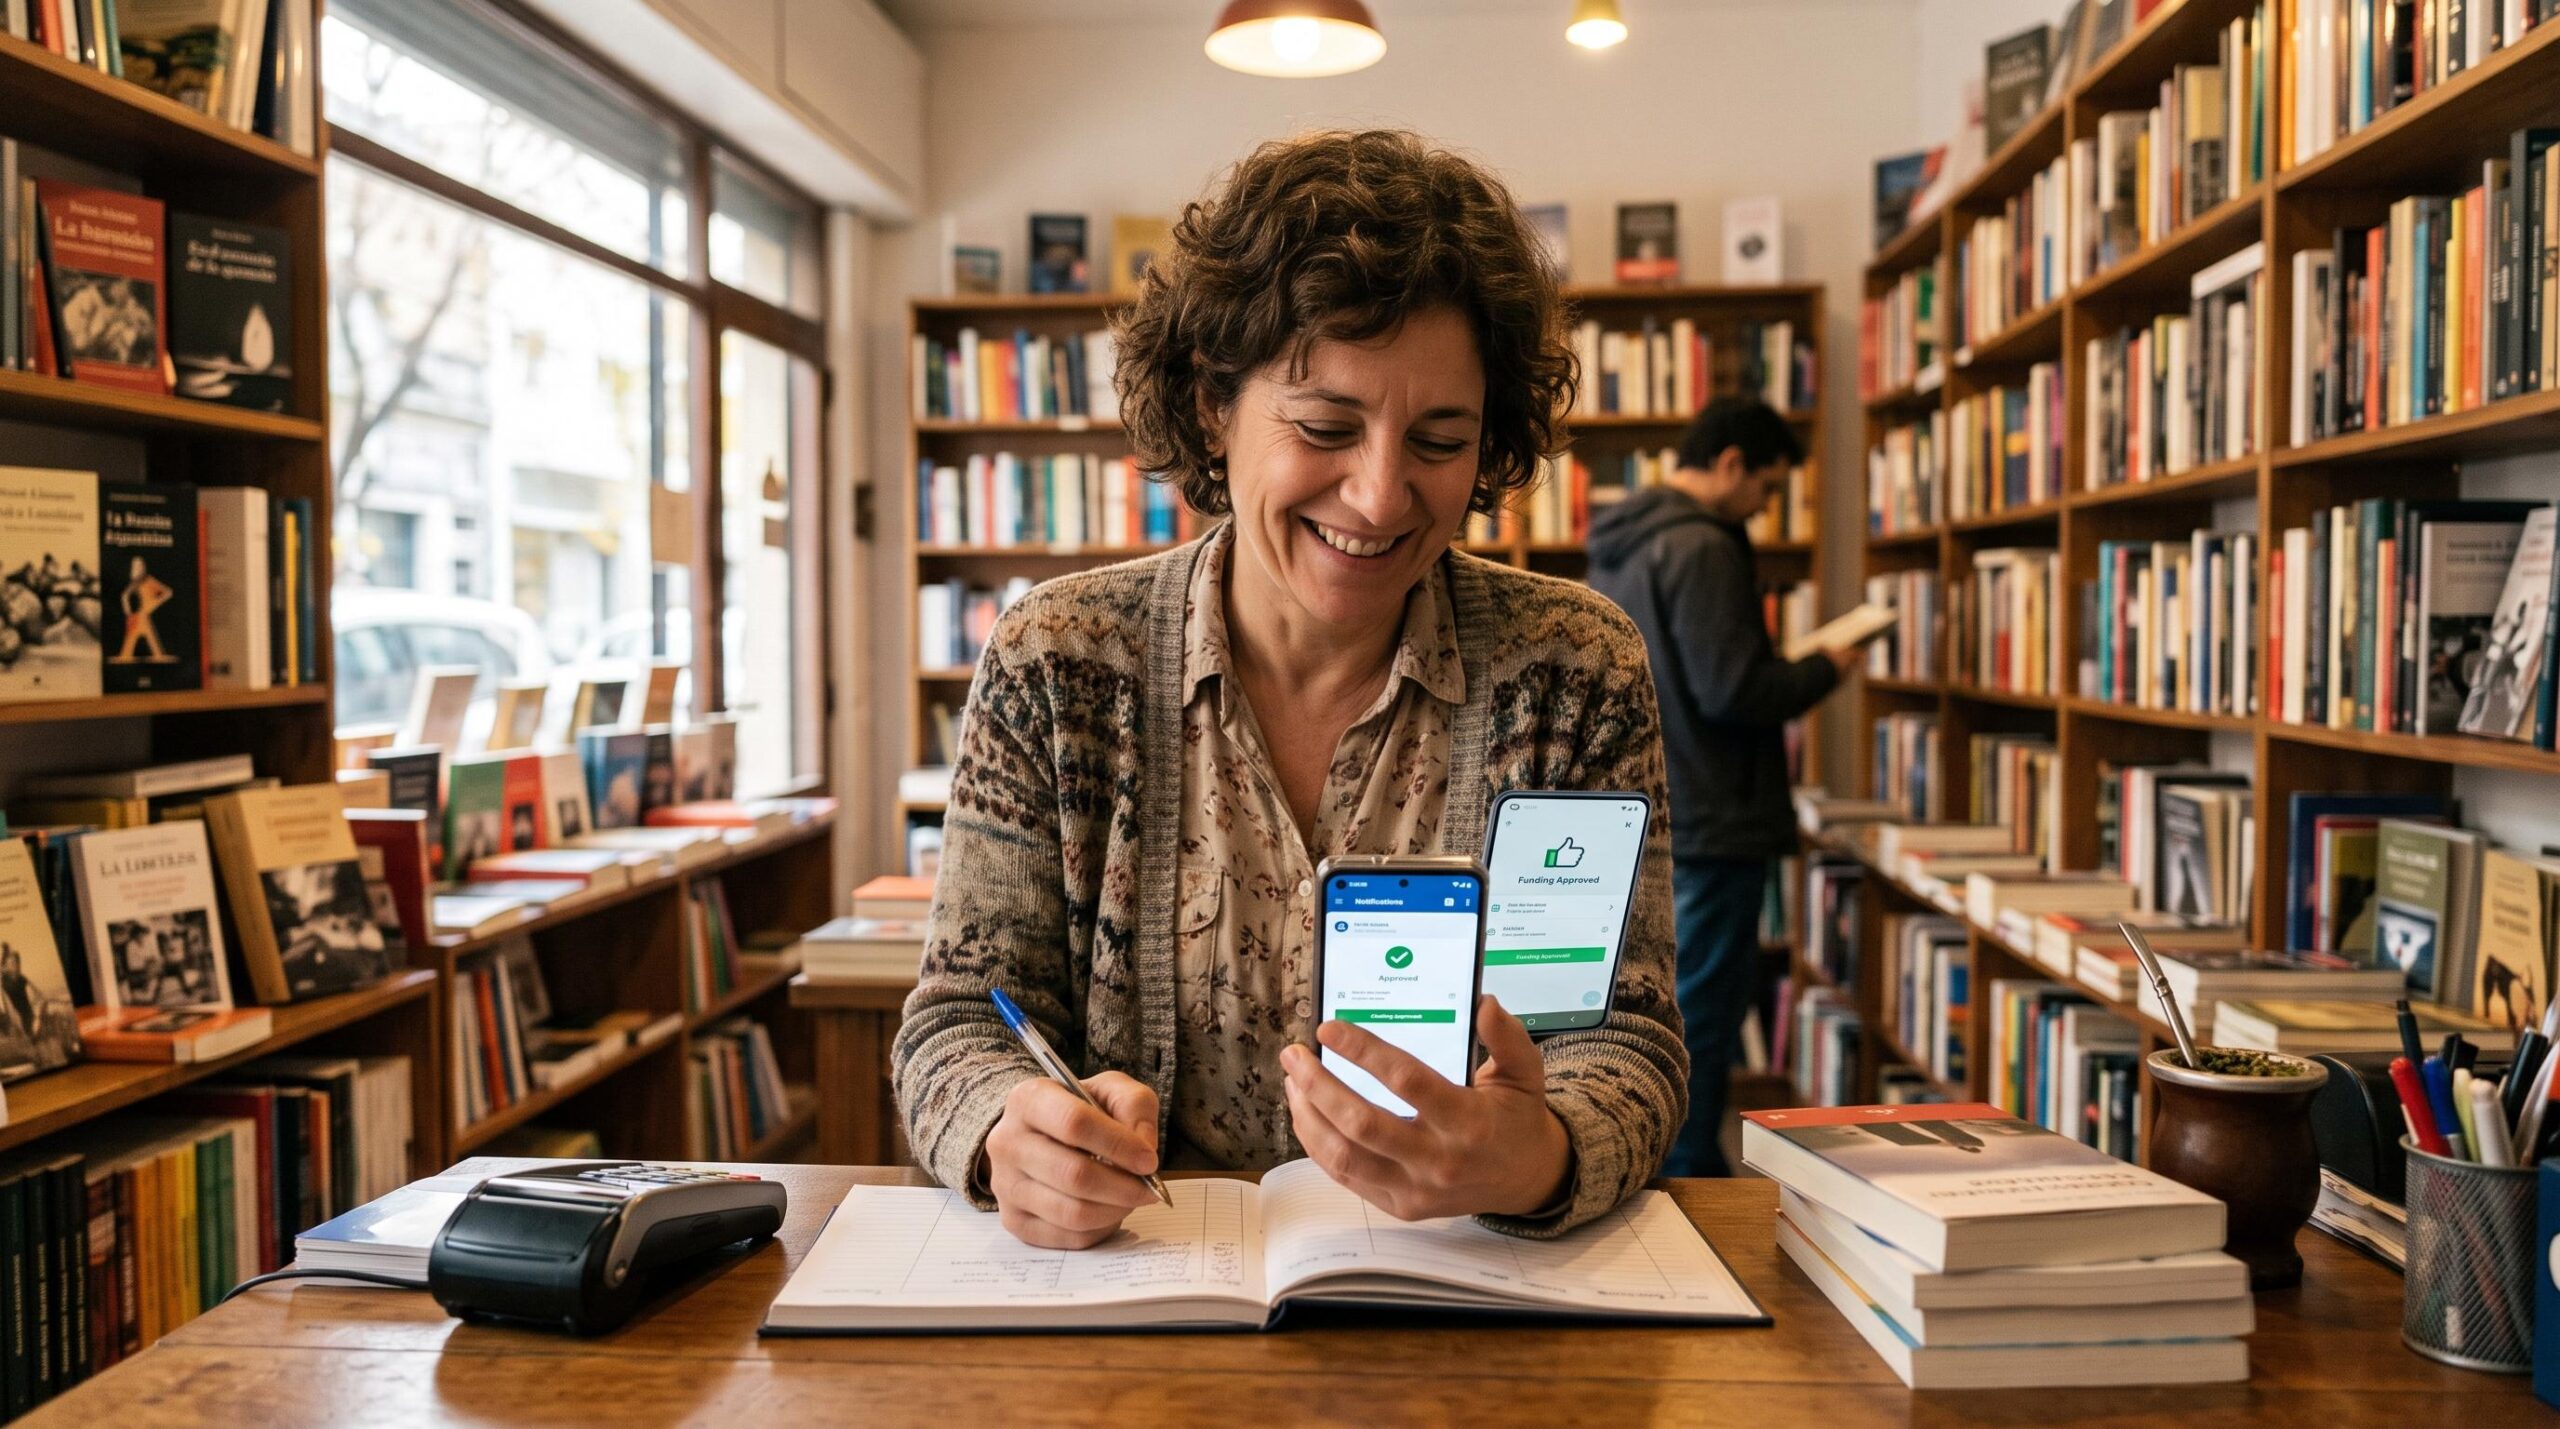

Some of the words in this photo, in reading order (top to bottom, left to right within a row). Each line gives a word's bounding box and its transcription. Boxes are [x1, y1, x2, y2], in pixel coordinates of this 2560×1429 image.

[1518, 876, 1554, 886] Funding
[1556, 876, 1600, 886] Approved
[1354, 898, 1404, 906] Notifications
